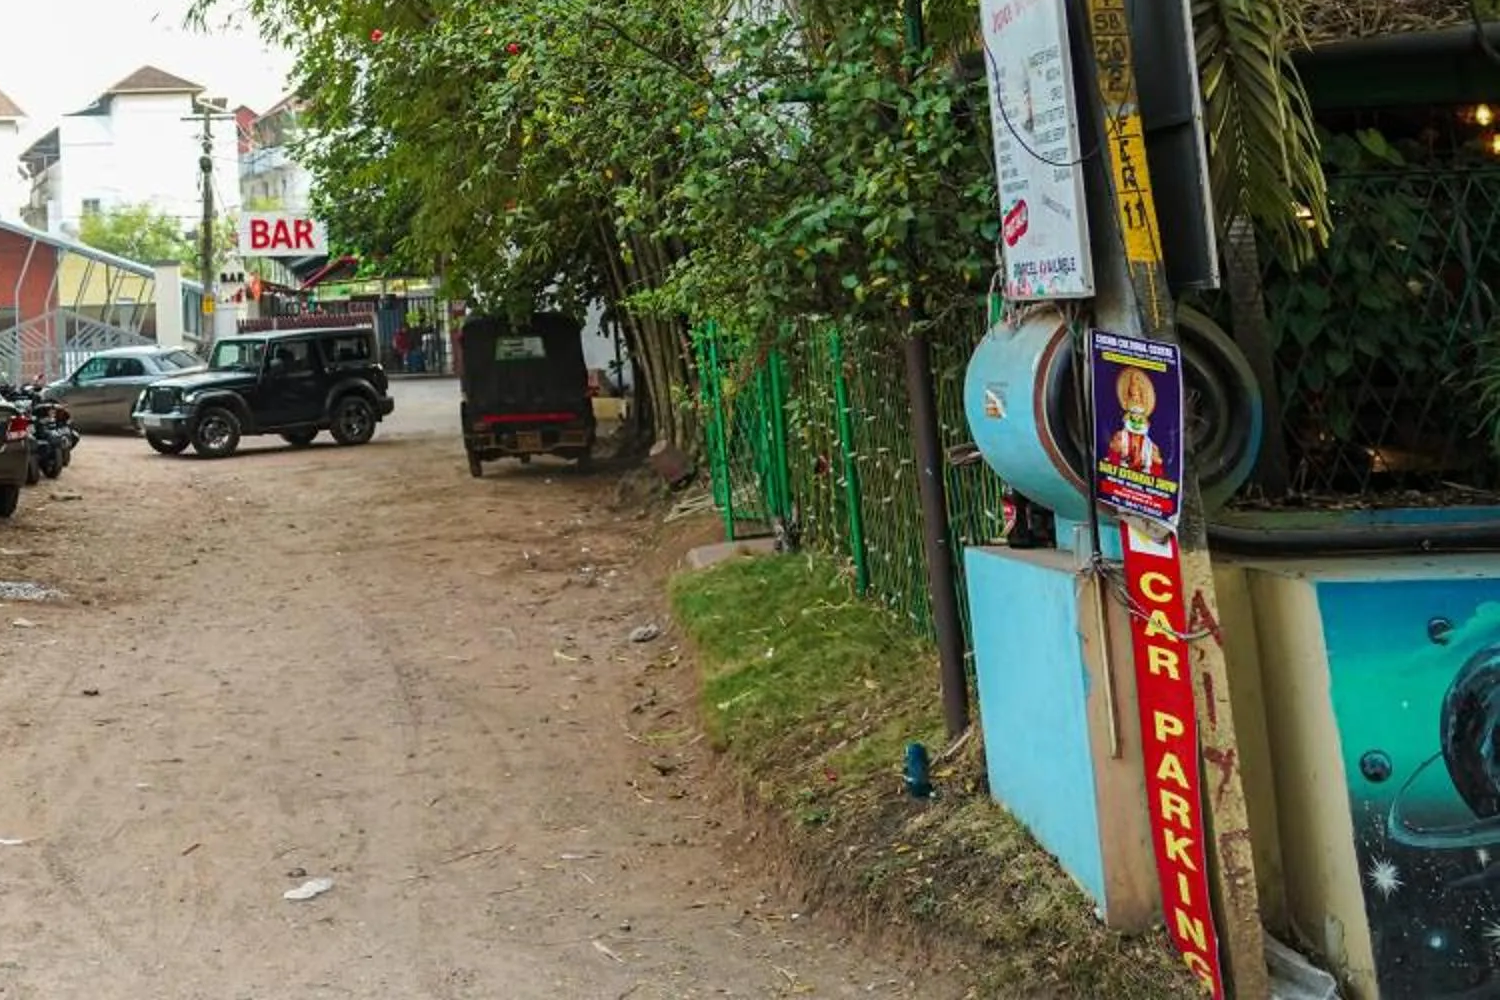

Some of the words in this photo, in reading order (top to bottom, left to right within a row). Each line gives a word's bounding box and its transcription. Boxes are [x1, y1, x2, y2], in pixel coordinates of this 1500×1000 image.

[250, 219, 315, 250] BAR
[220, 272, 245, 283] BAR
[1138, 571, 1182, 682] CAR
[1153, 711, 1216, 994] PARKING
